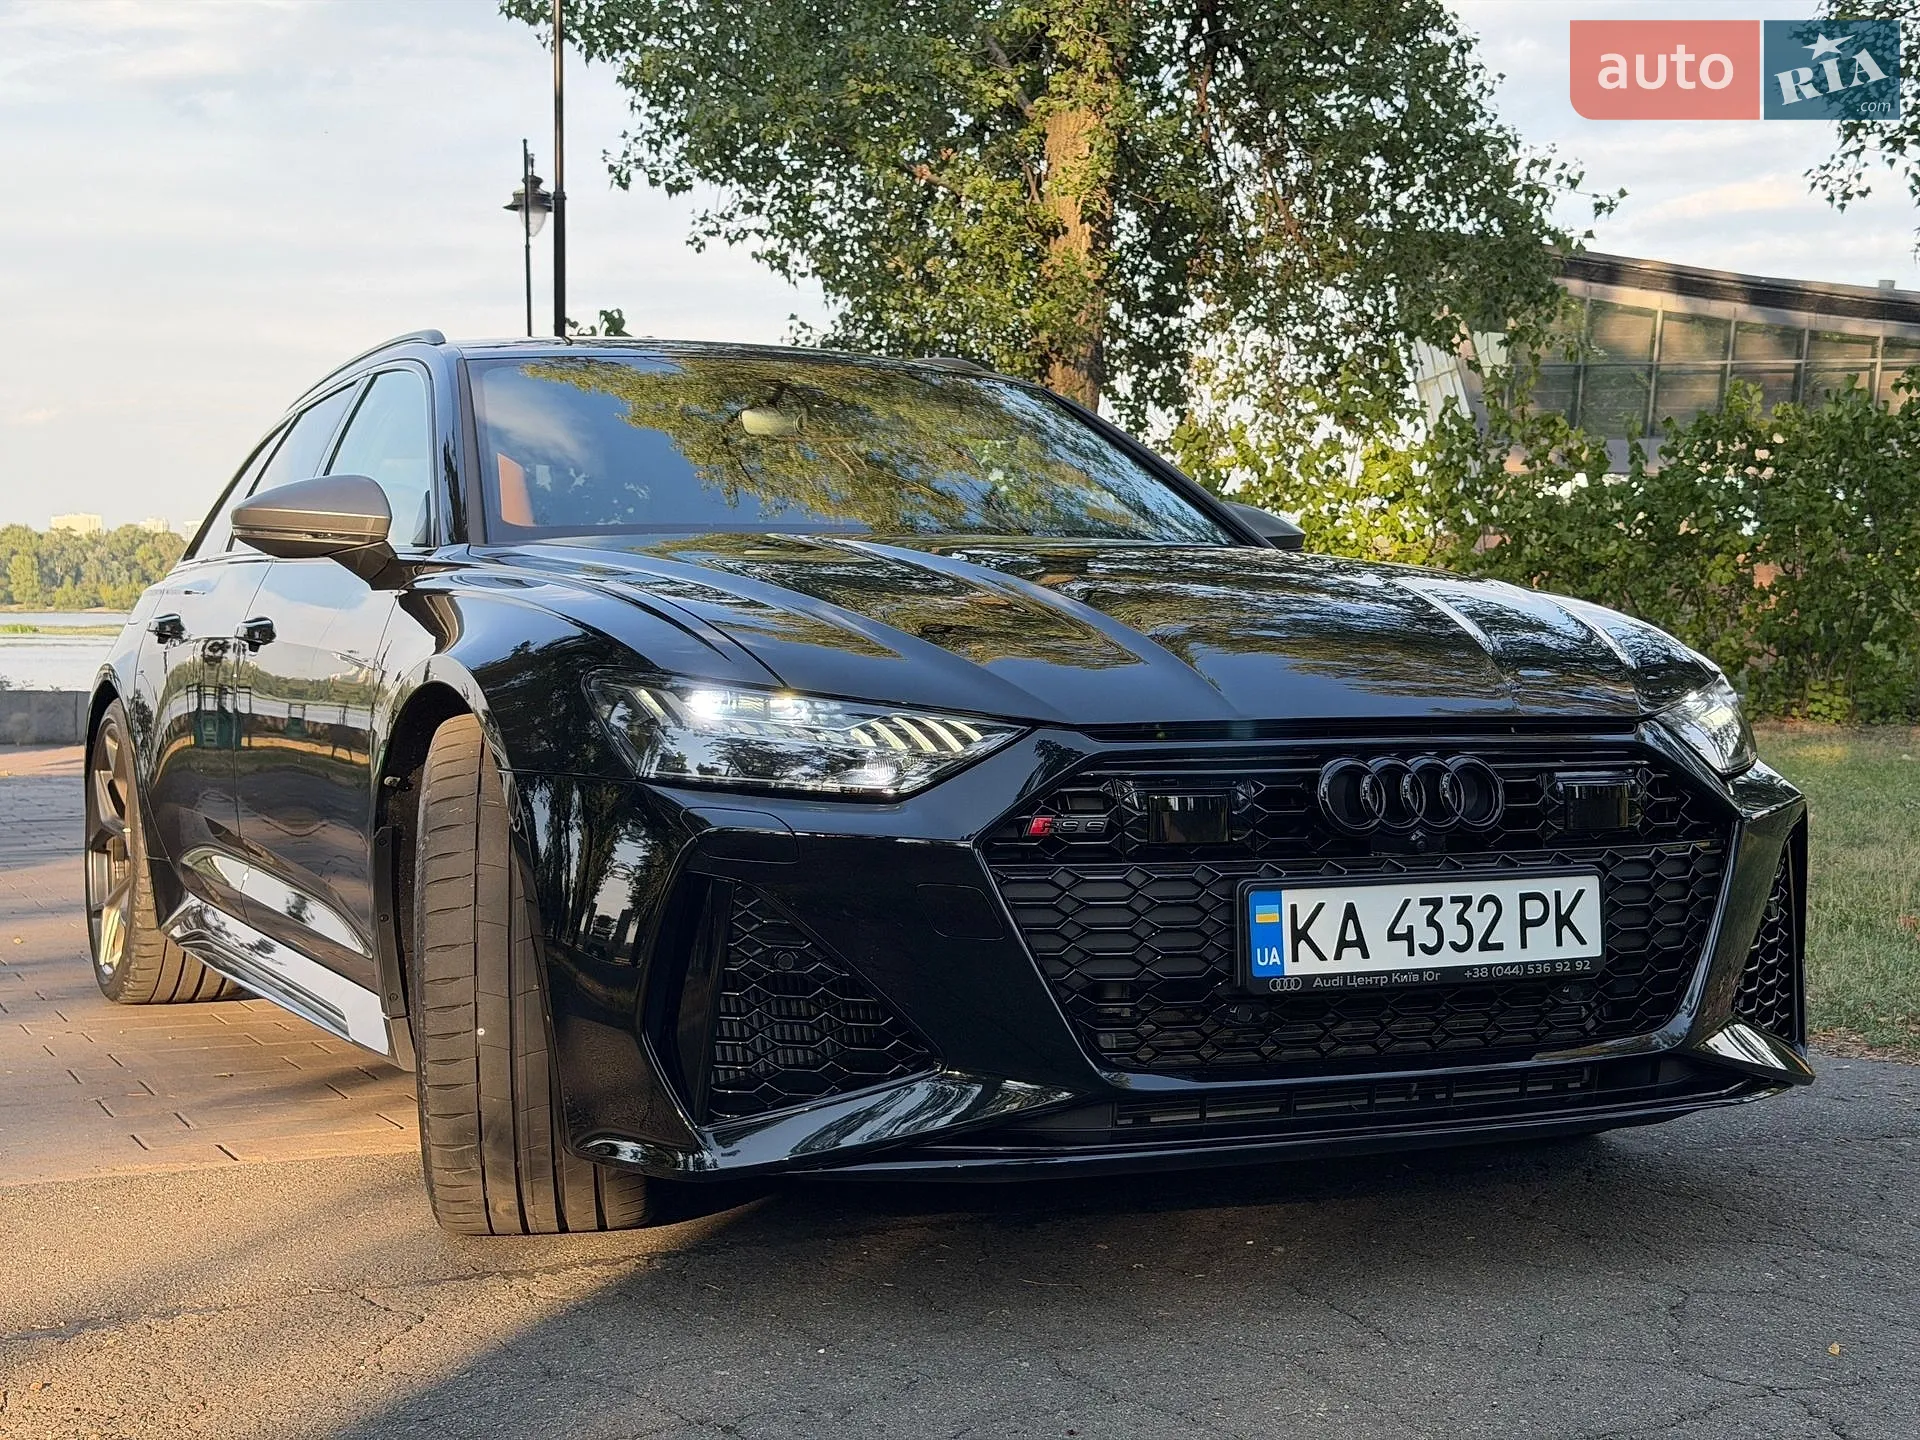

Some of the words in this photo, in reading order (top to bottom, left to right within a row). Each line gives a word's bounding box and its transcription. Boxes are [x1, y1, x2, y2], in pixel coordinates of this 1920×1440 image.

[1289, 901, 1371, 963] KA
[1386, 893, 1505, 957] 4332
[1518, 888, 1588, 949] PK
[1256, 946, 1282, 967] UA
[1312, 976, 1344, 988] Audi
[1346, 974, 1389, 987] Центр
[1391, 971, 1420, 983] Київ
[1423, 970, 1441, 982] Юг
[1464, 966, 1489, 979] +38
[1491, 964, 1524, 978] (044)
[1527, 962, 1551, 975] 536
[1555, 960, 1571, 972] 92
[1575, 959, 1592, 971] 92
